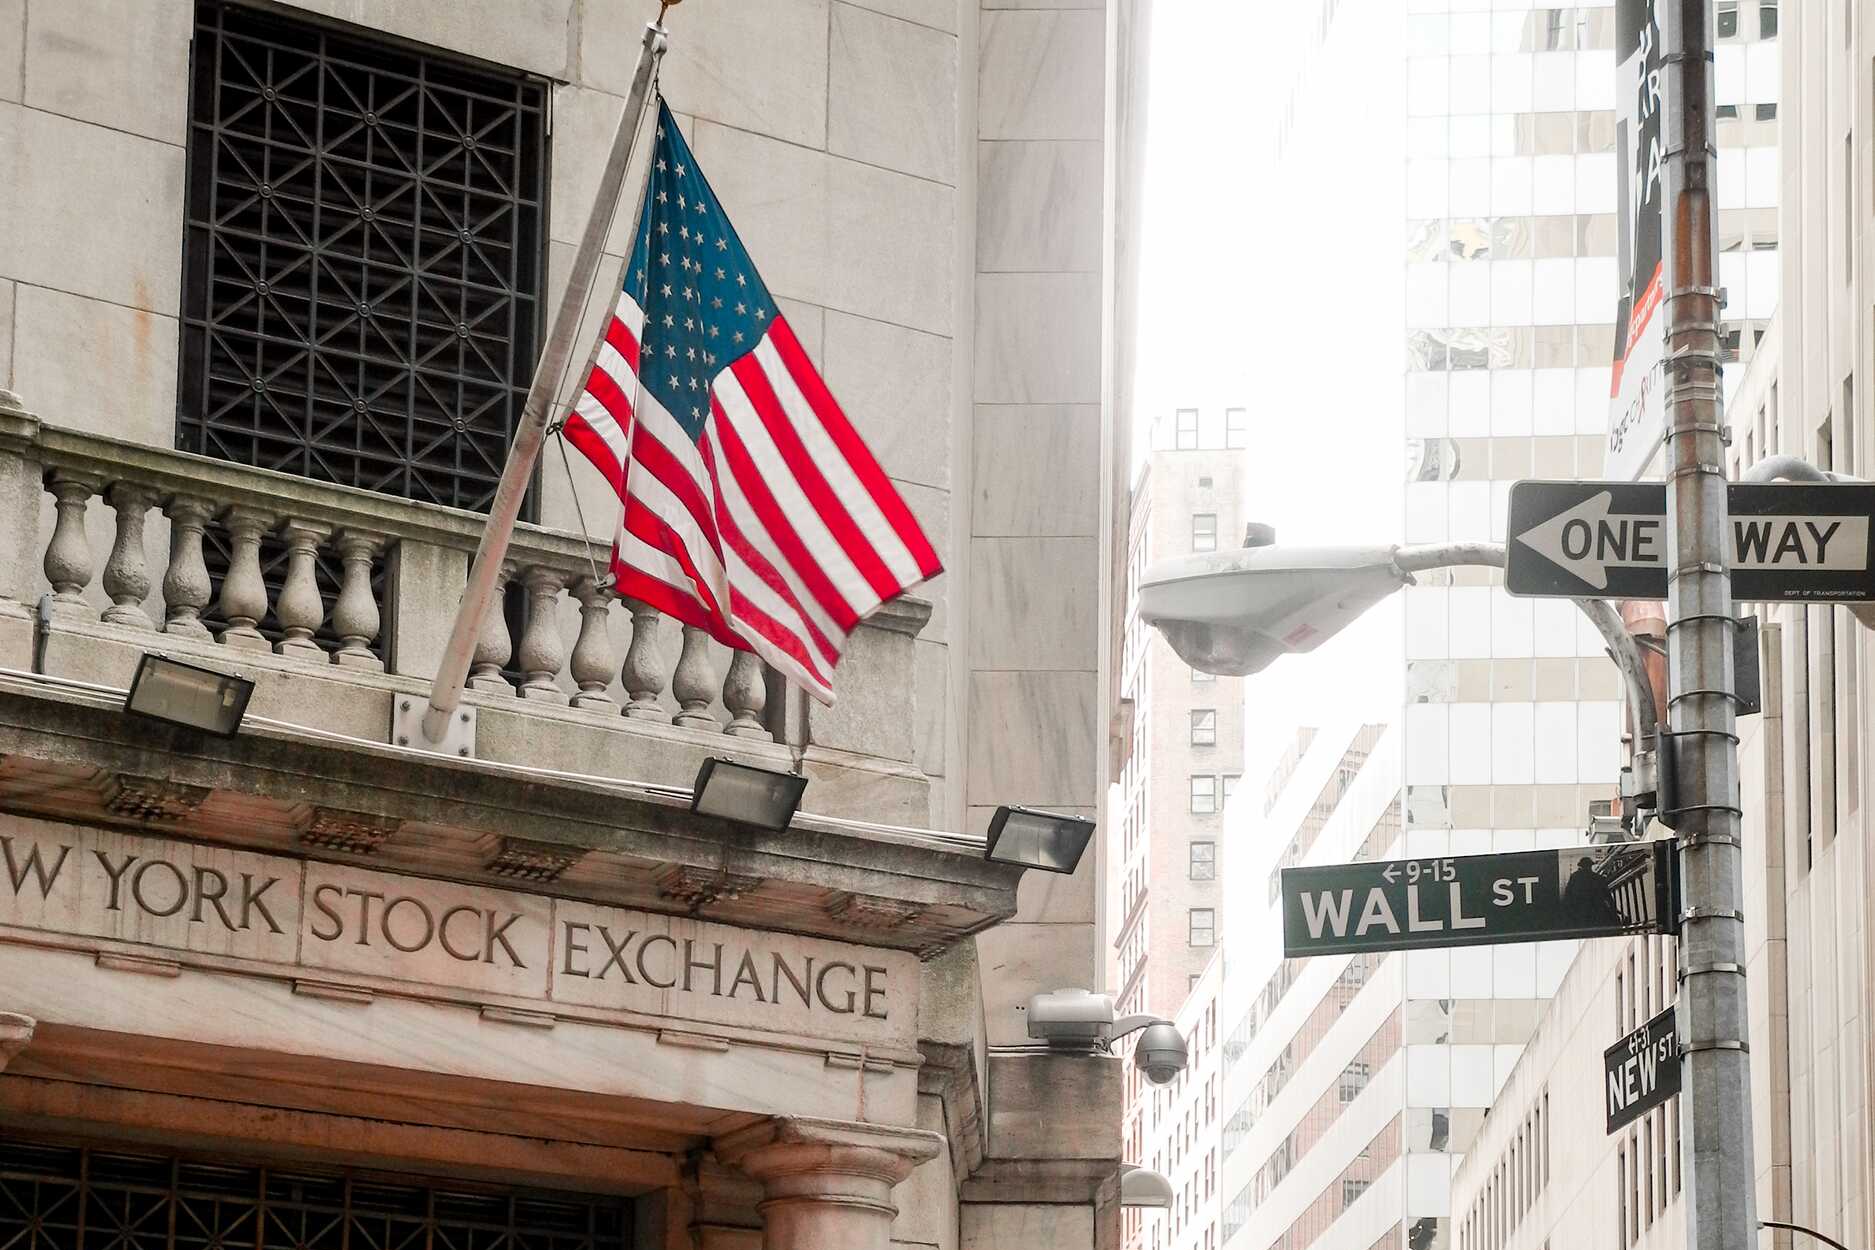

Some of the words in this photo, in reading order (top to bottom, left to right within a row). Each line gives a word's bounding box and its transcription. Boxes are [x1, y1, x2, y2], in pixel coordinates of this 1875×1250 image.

[1560, 518, 1660, 562] ONE
[1734, 520, 1841, 564] WAY
[1406, 859, 1457, 882] 9-15
[91, 848, 284, 934] YORK
[311, 883, 527, 969] STOCK
[562, 920, 888, 1020] EXCHANGE
[1300, 881, 1487, 939] WALL
[1492, 876, 1540, 907] ST
[1608, 1042, 1657, 1117] NEW
[1659, 1031, 1674, 1062] ST
